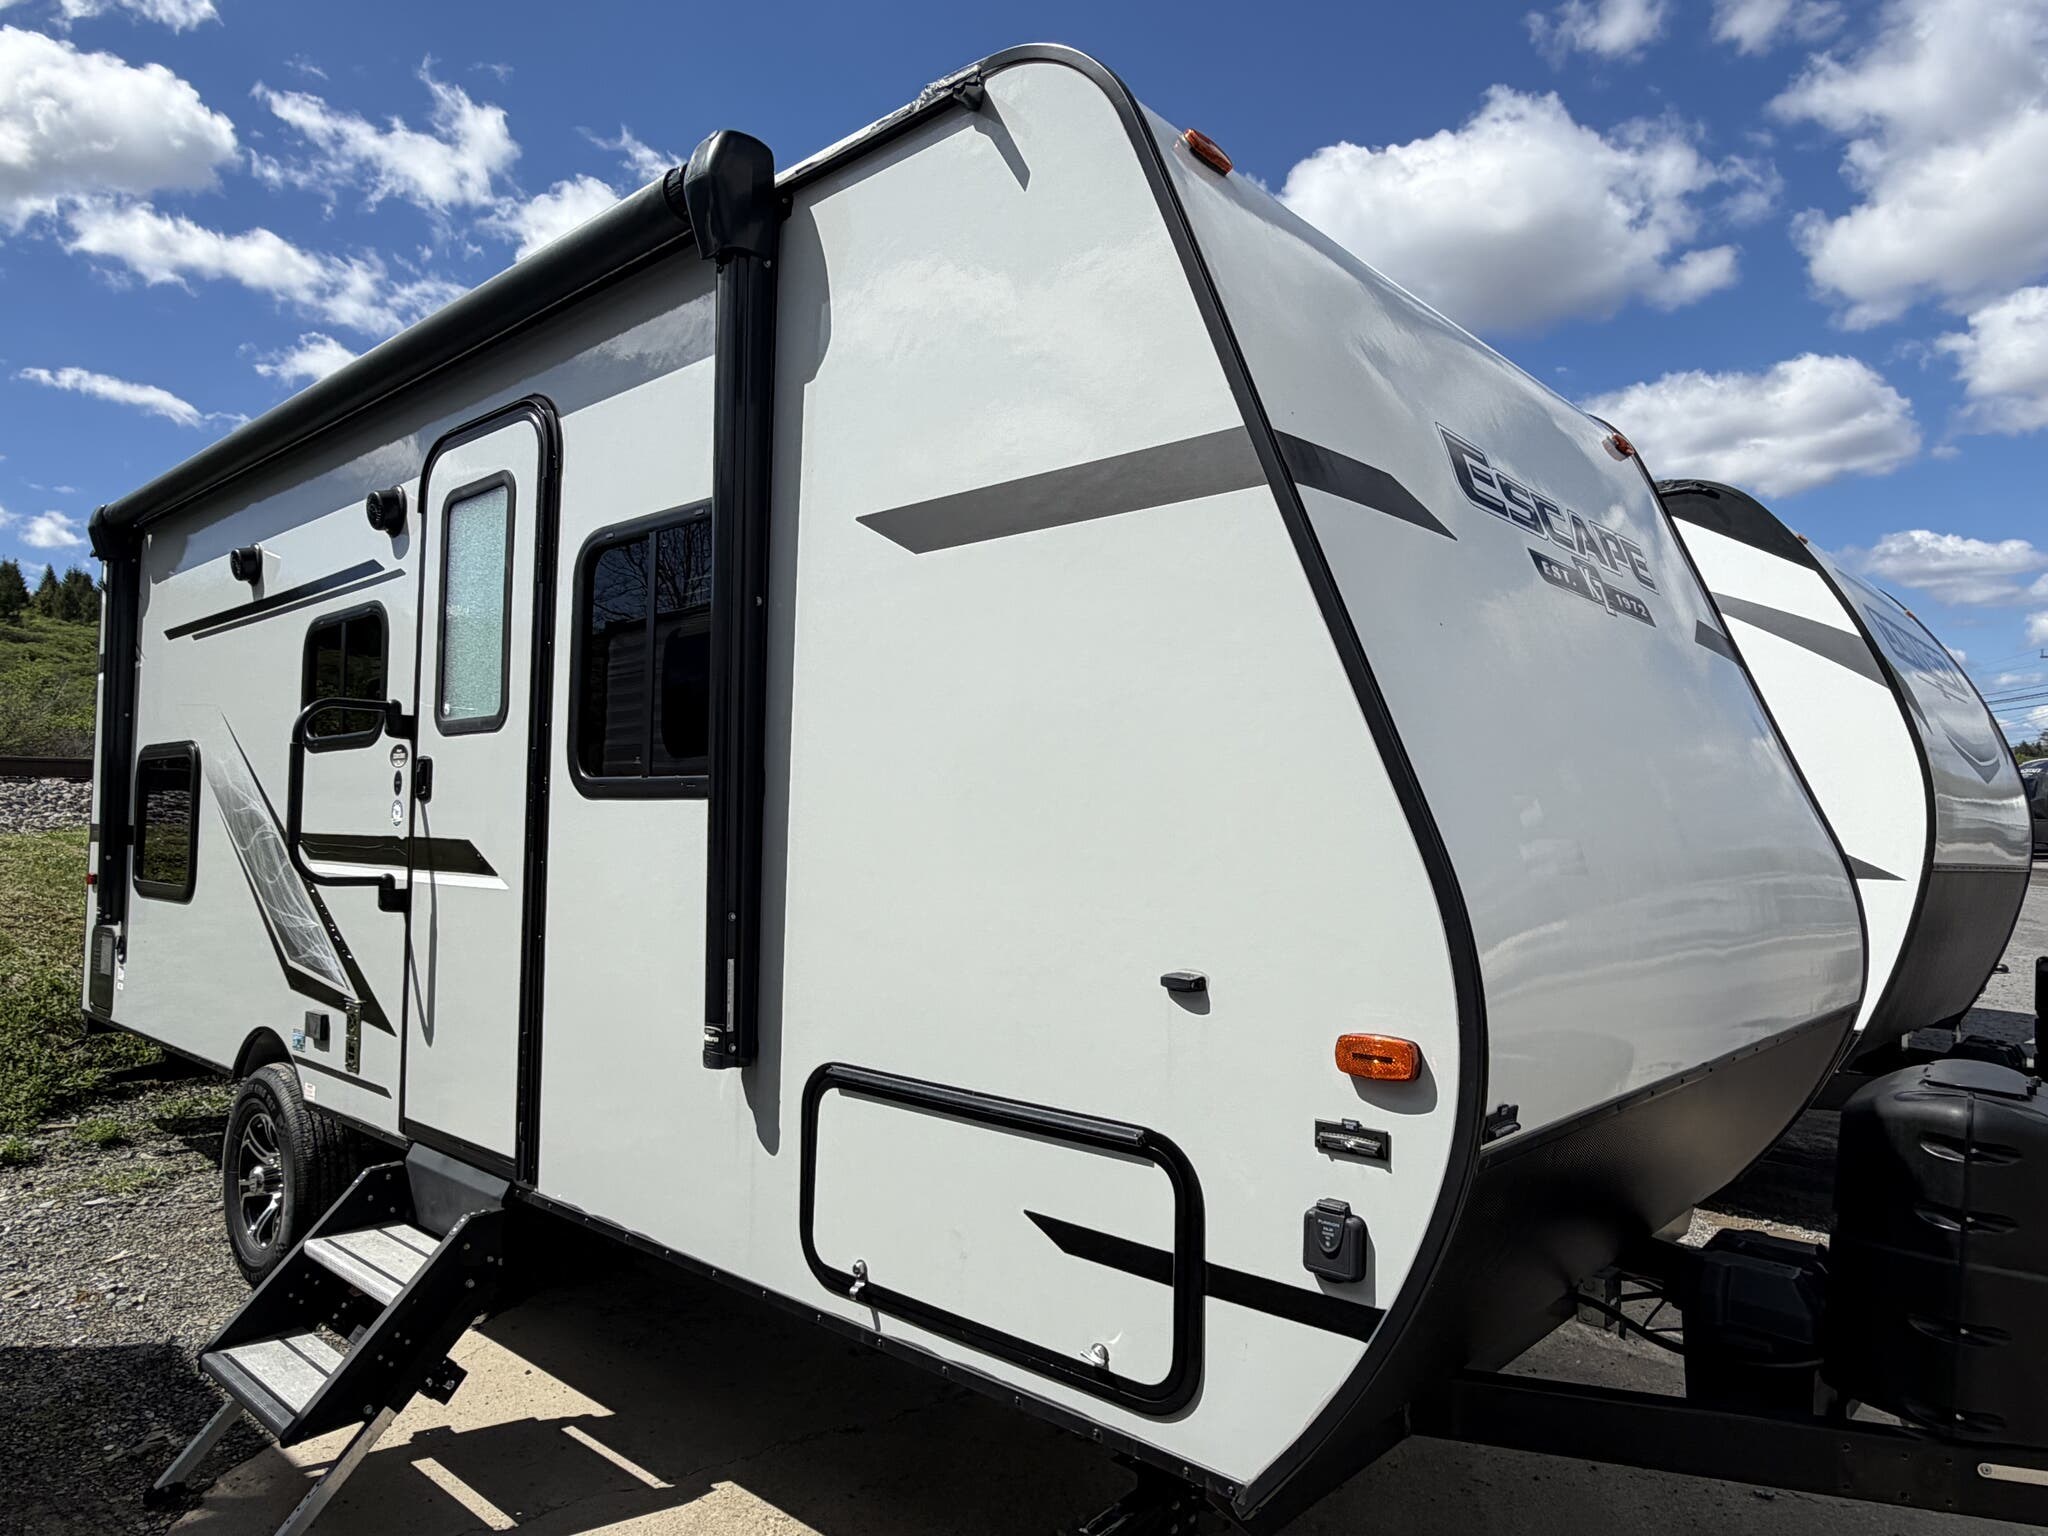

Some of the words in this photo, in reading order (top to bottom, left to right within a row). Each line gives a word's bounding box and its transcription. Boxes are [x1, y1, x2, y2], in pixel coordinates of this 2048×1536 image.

[1435, 422, 1659, 595] ESCAPE
[1541, 560, 1577, 586] EST.
[1615, 594, 1650, 616] 1972
